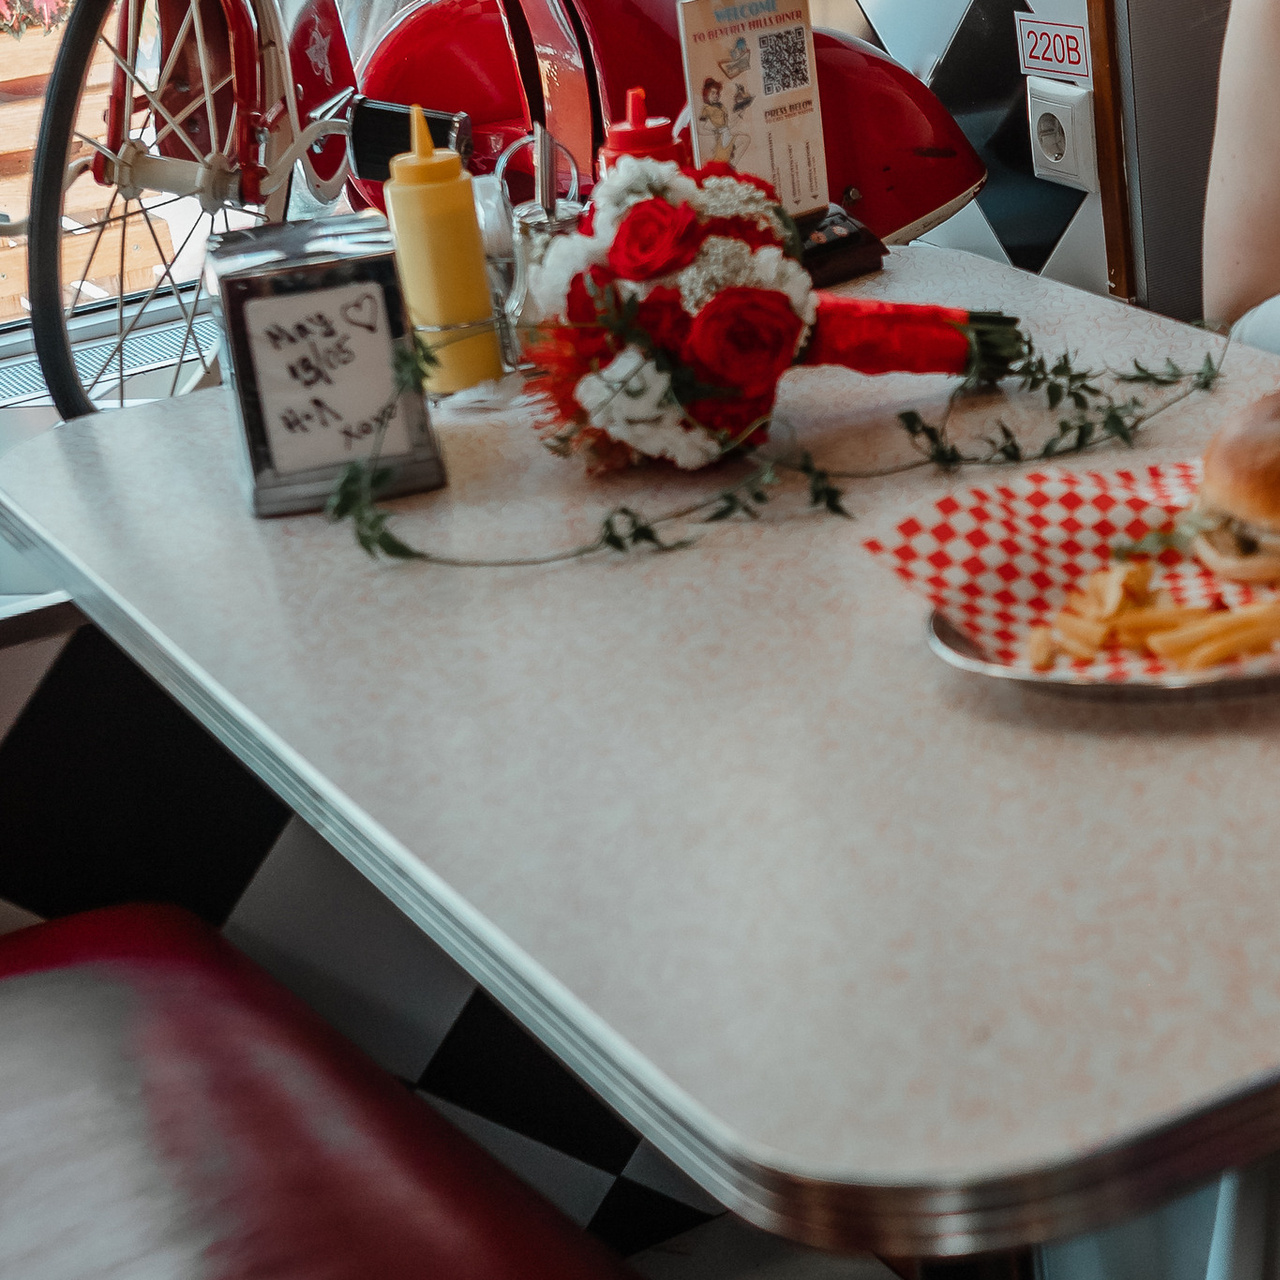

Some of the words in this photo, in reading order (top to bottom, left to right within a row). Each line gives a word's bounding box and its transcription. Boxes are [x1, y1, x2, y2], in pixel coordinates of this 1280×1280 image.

[693, 32, 707, 44] TO
[708, 23, 746, 41] BEVERLY
[748, 18, 774, 31] HILLS
[775, 11, 802, 26] DINER
[1027, 30, 1081, 65] 220B
[765, 108, 788, 120] PRESS
[789, 99, 813, 112] BELOW
[265, 312, 336, 350] May
